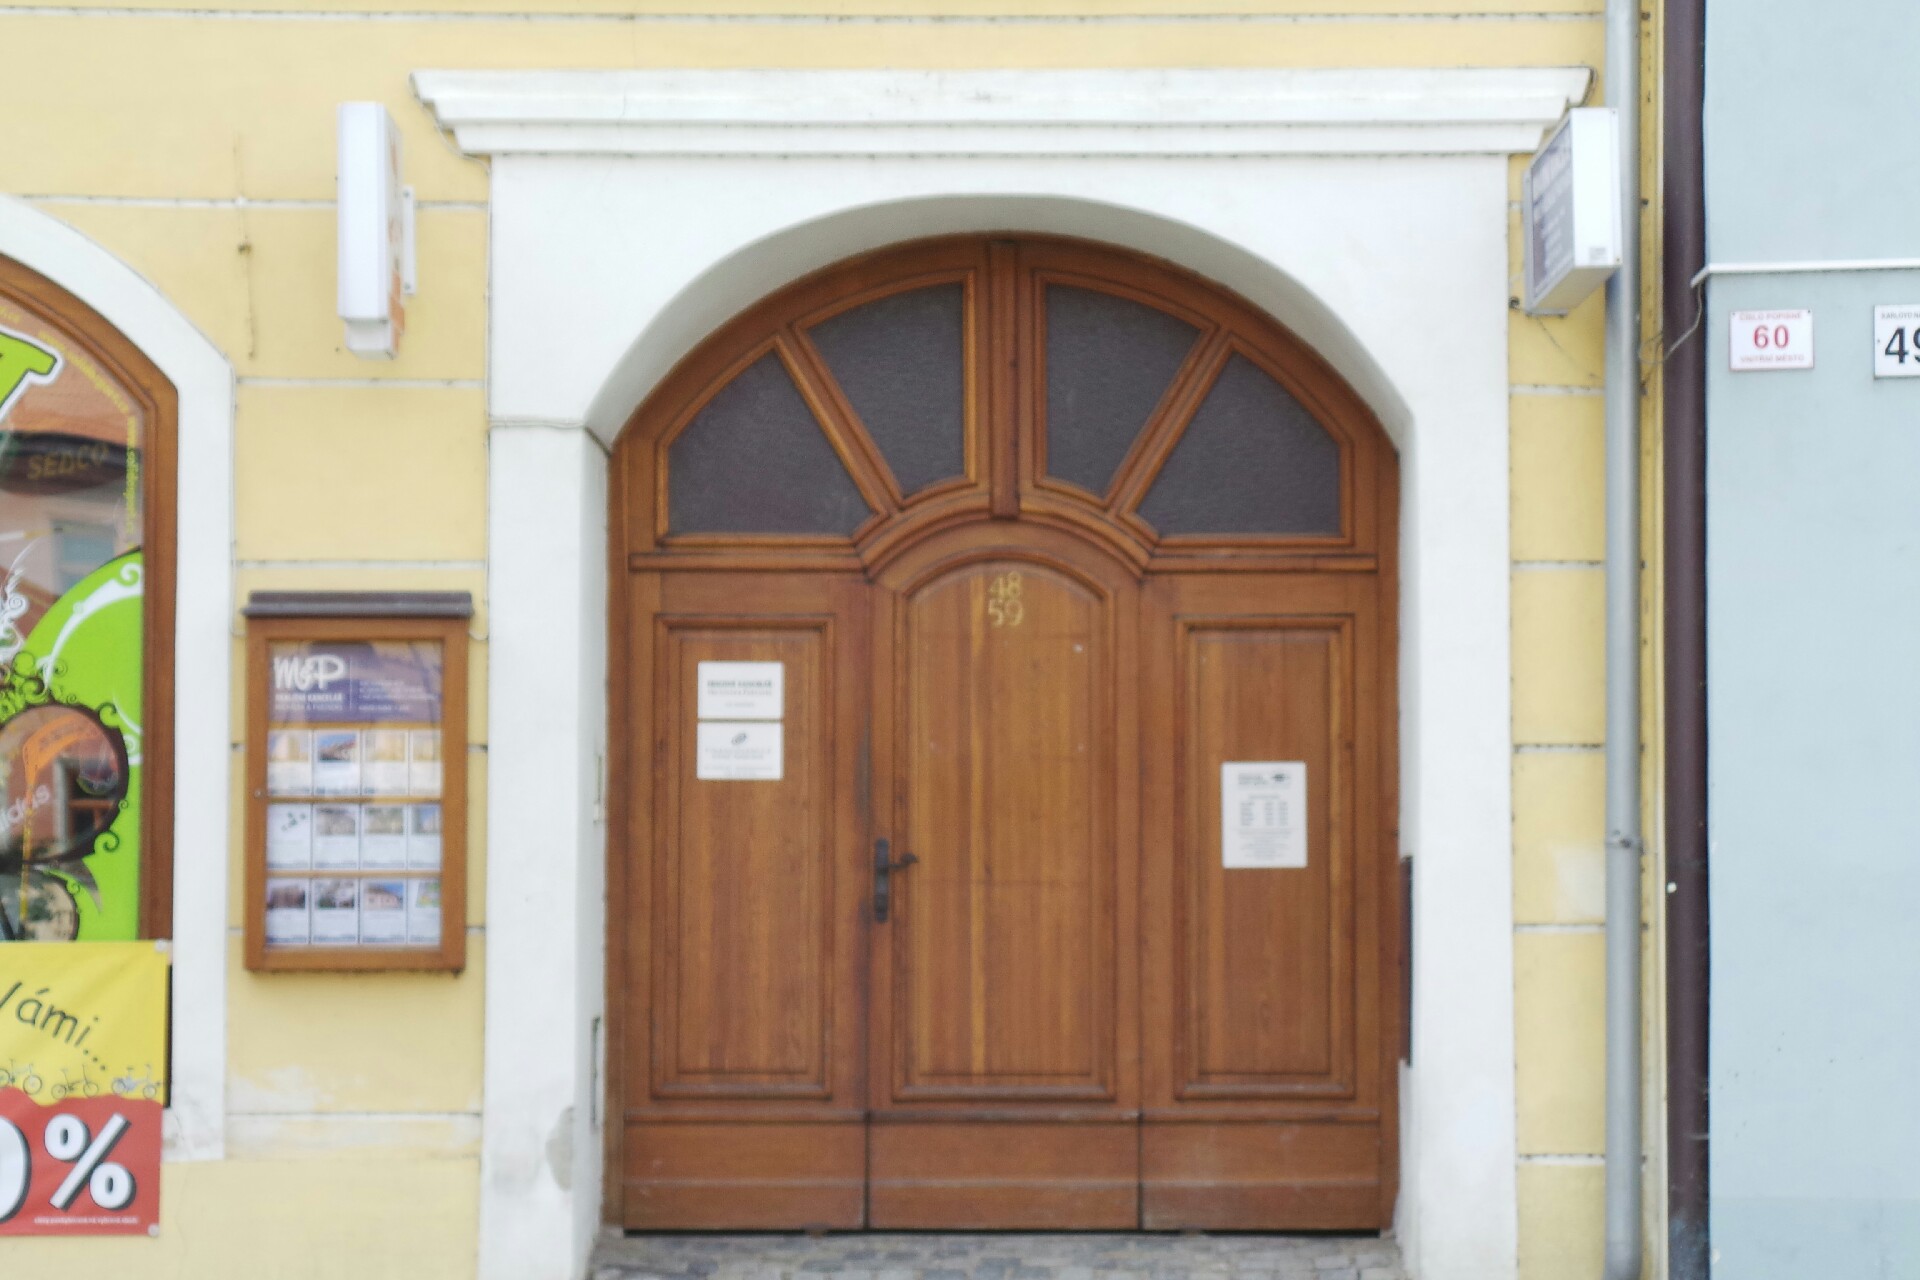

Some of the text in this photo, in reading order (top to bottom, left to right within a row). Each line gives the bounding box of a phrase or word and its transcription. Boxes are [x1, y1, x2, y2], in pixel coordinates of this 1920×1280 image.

[1754, 325, 1789, 348] 60
[988, 571, 1022, 603] 48
[988, 599, 1023, 626] 59
